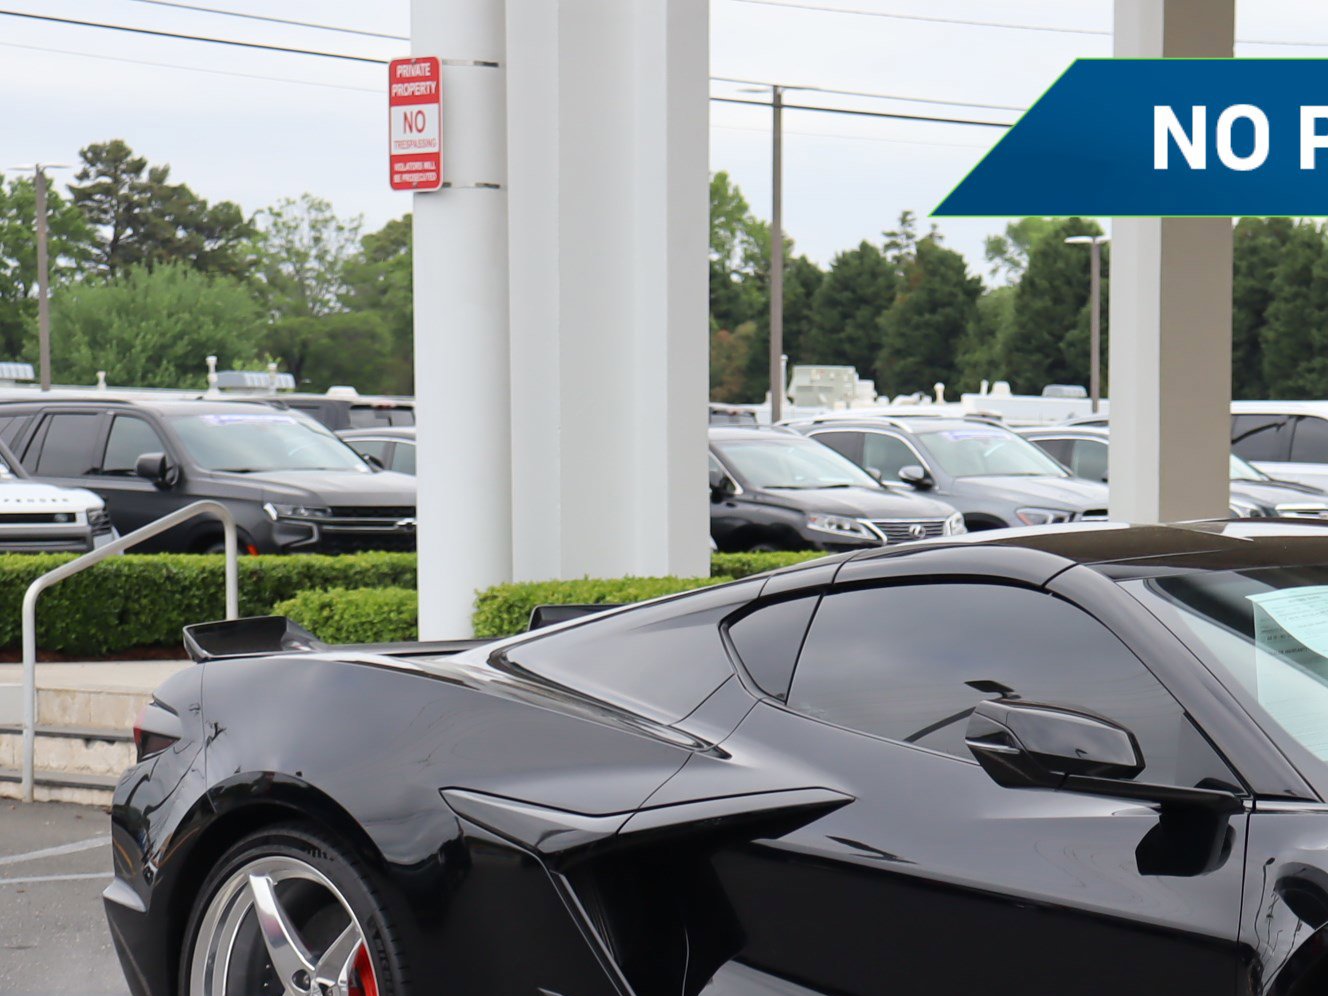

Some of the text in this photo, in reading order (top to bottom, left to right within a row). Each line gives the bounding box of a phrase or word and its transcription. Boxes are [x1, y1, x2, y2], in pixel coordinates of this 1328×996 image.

[396, 63, 431, 78] PRIVATE
[391, 81, 437, 97] PROPERTY
[403, 110, 426, 134] NO
